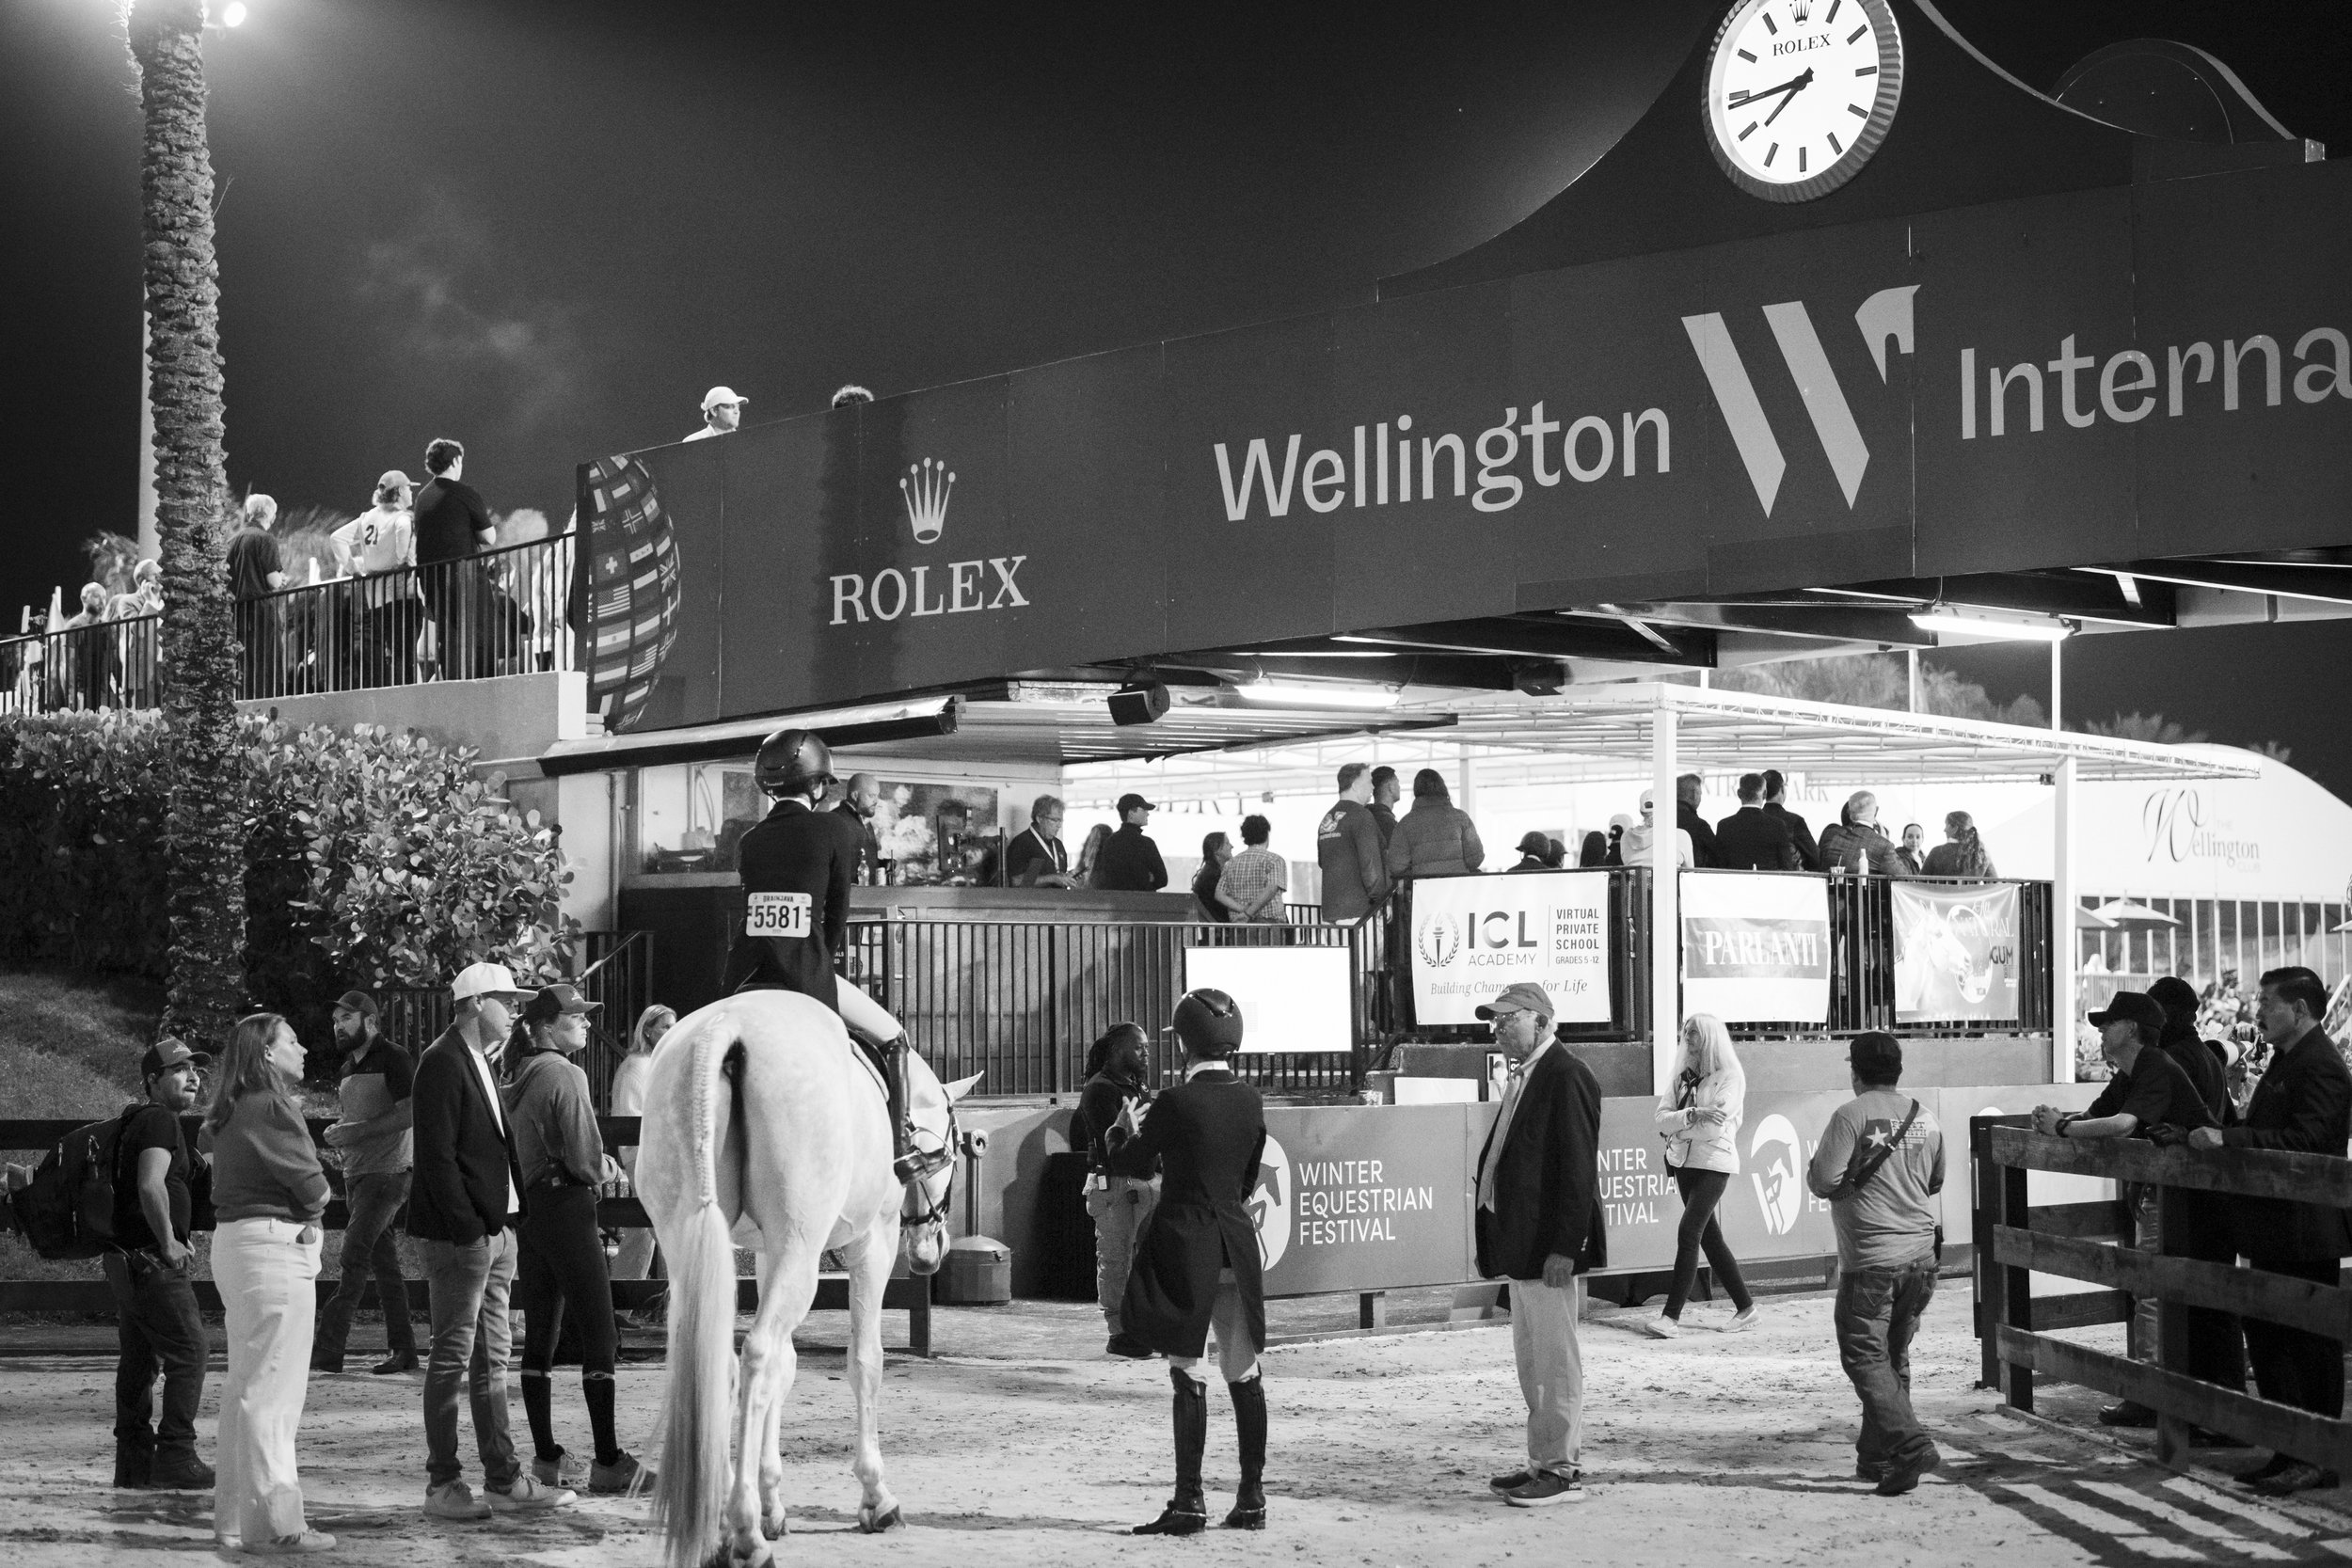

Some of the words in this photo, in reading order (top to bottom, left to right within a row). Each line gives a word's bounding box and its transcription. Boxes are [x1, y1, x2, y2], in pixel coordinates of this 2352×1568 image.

[1772, 34, 1832, 56] ROLEX
[1214, 400, 1671, 522] Wellington
[1961, 326, 2352, 440] Interna
[364, 524, 379, 546] 21
[829, 555, 1030, 626] ROLEX
[754, 905, 800, 929] 5581
[1556, 908, 1599, 920] VIRTUAL
[1468, 911, 1538, 949] ICL
[1556, 923, 1599, 935] PRIVATE
[1555, 938, 1599, 950] SCHOOL
[1704, 930, 1820, 966] PARLANTI
[1990, 945, 2013, 965] GUM
[1468, 952, 1537, 967] ACADEMY
[1555, 956, 1583, 964] GRADES
[1430, 981, 1472, 997] Building
[1542, 979, 1561, 992] for
[1564, 978, 1588, 995] Life
[1597, 1148, 1647, 1172] NTER
[1299, 1160, 1384, 1187] WINTER
[1599, 1173, 1678, 1199] UESTRIA
[1299, 1186, 1433, 1219] EQUESTRIAN
[1605, 1201, 1660, 1227] TIVAL
[1299, 1217, 1396, 1245] FESTIVAL
